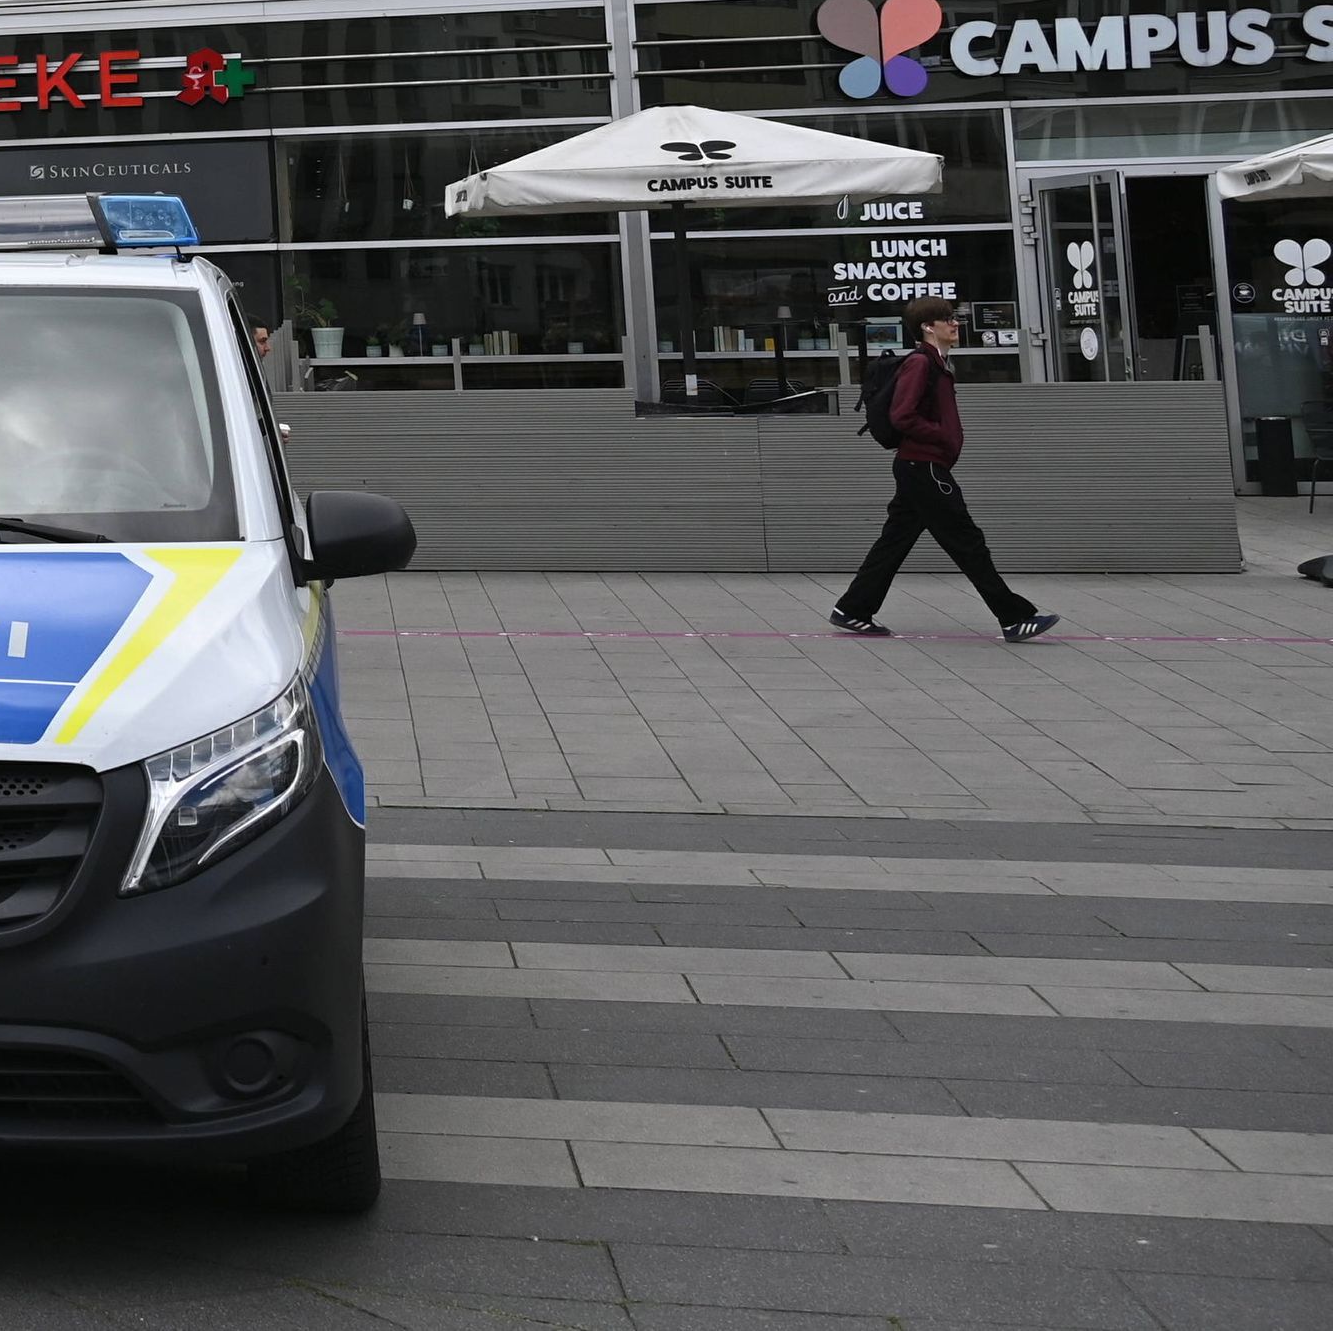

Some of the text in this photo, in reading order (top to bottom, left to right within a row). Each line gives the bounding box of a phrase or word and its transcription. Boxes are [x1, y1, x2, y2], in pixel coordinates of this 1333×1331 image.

[949, 8, 1275, 77] CAMPUS
[647, 175, 774, 192] CAMPUS SUITE
[860, 201, 923, 221] JUICE
[870, 239, 947, 257] LUNCH
[833, 260, 927, 280] SNACKS
[827, 282, 957, 303] and COFFEE
[1074, 303, 1097, 317] SUITE
[1284, 301, 1331, 313] SUITE
